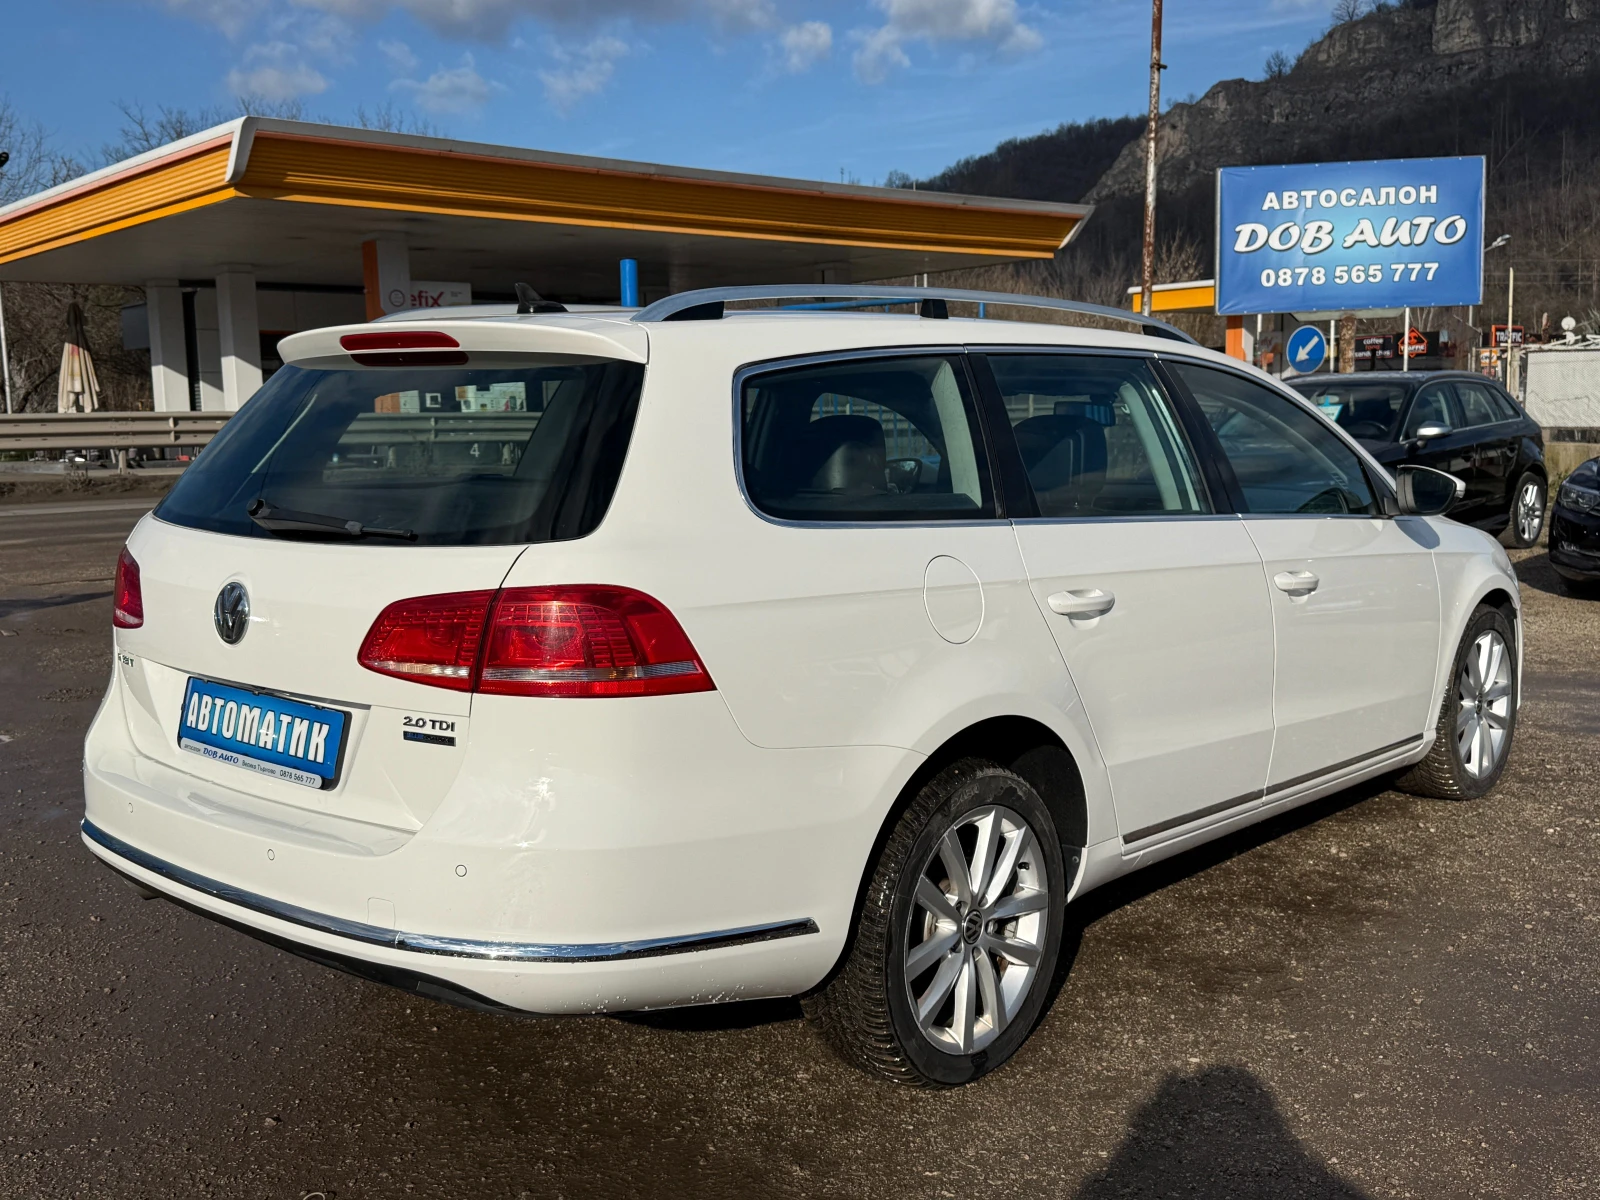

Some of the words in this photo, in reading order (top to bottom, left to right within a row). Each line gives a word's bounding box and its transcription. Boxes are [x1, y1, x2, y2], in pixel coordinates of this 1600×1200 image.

[1261, 184, 1438, 211] АВТОСАЛОН
[1233, 220, 1334, 255] DOB
[1342, 214, 1467, 249] AUTO
[1260, 266, 1326, 288] 0878
[1334, 264, 1383, 285] 565
[1390, 261, 1440, 282] 777
[185, 690, 331, 765] АВТОМАТИК
[428, 719, 456, 732] TDI
[203, 747, 218, 759] DOB
[218, 752, 239, 764] AUTO
[279, 769, 293, 780] 0878
[293, 773, 304, 782] 565
[305, 776, 316, 785] 777
